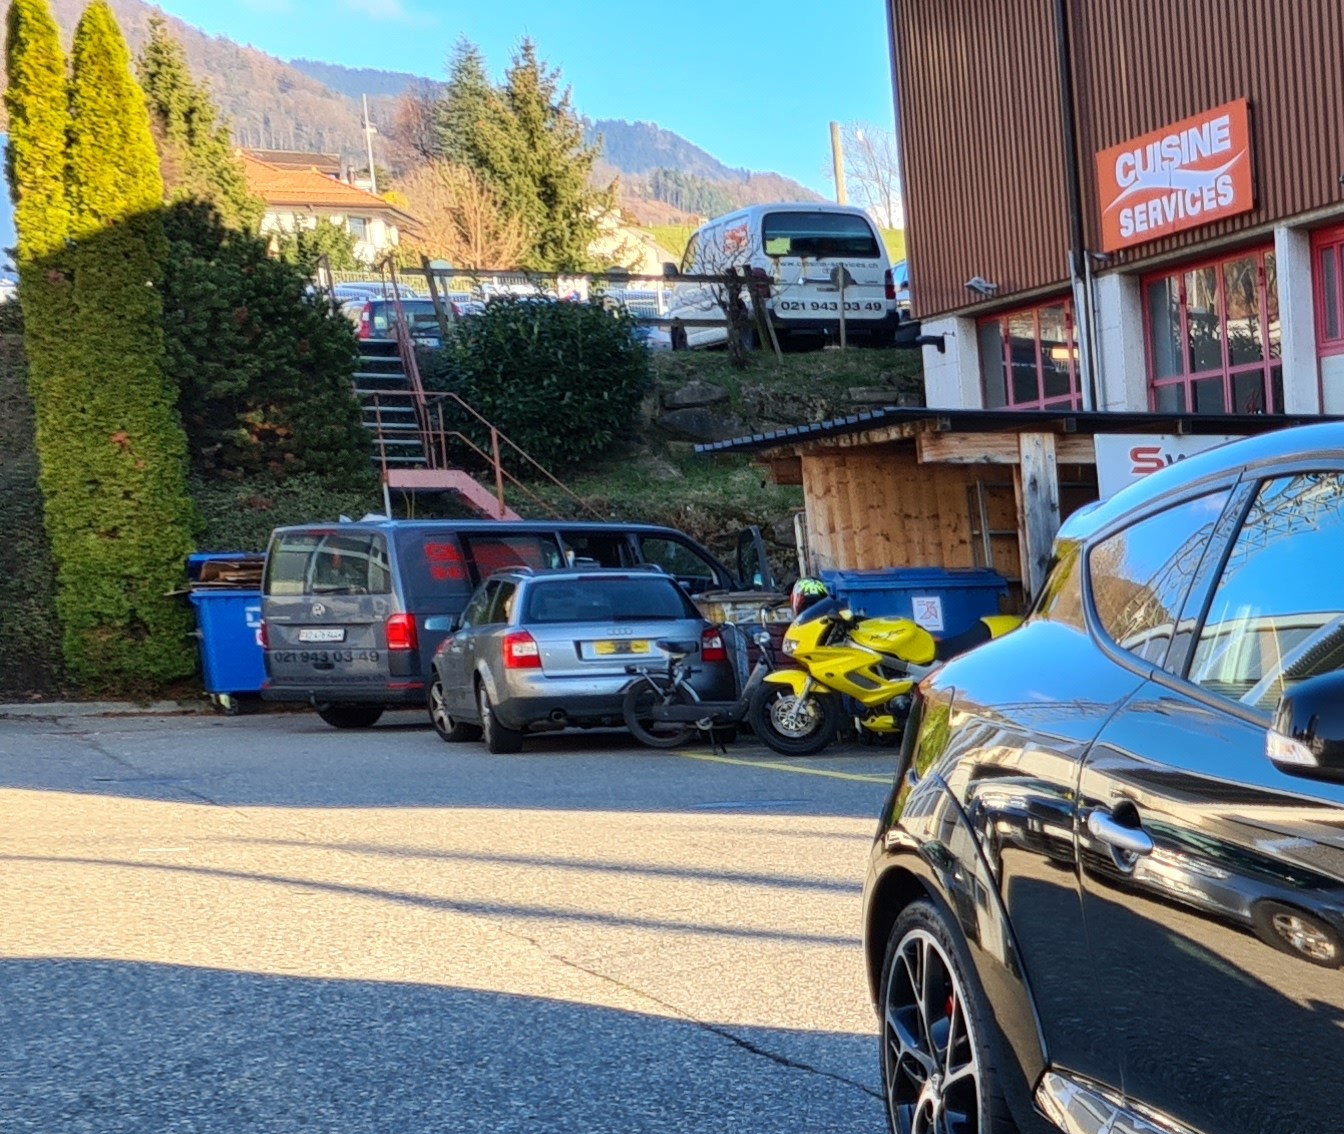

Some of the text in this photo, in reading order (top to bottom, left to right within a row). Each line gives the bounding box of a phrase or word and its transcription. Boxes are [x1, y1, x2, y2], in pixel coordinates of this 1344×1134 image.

[1115, 114, 1231, 188] CUISINE
[1119, 174, 1234, 238] SERVICES
[781, 301, 806, 311] 021
[810, 301, 838, 311] 943
[864, 302, 882, 311] 49
[275, 651, 379, 663] 021 943 03 49
